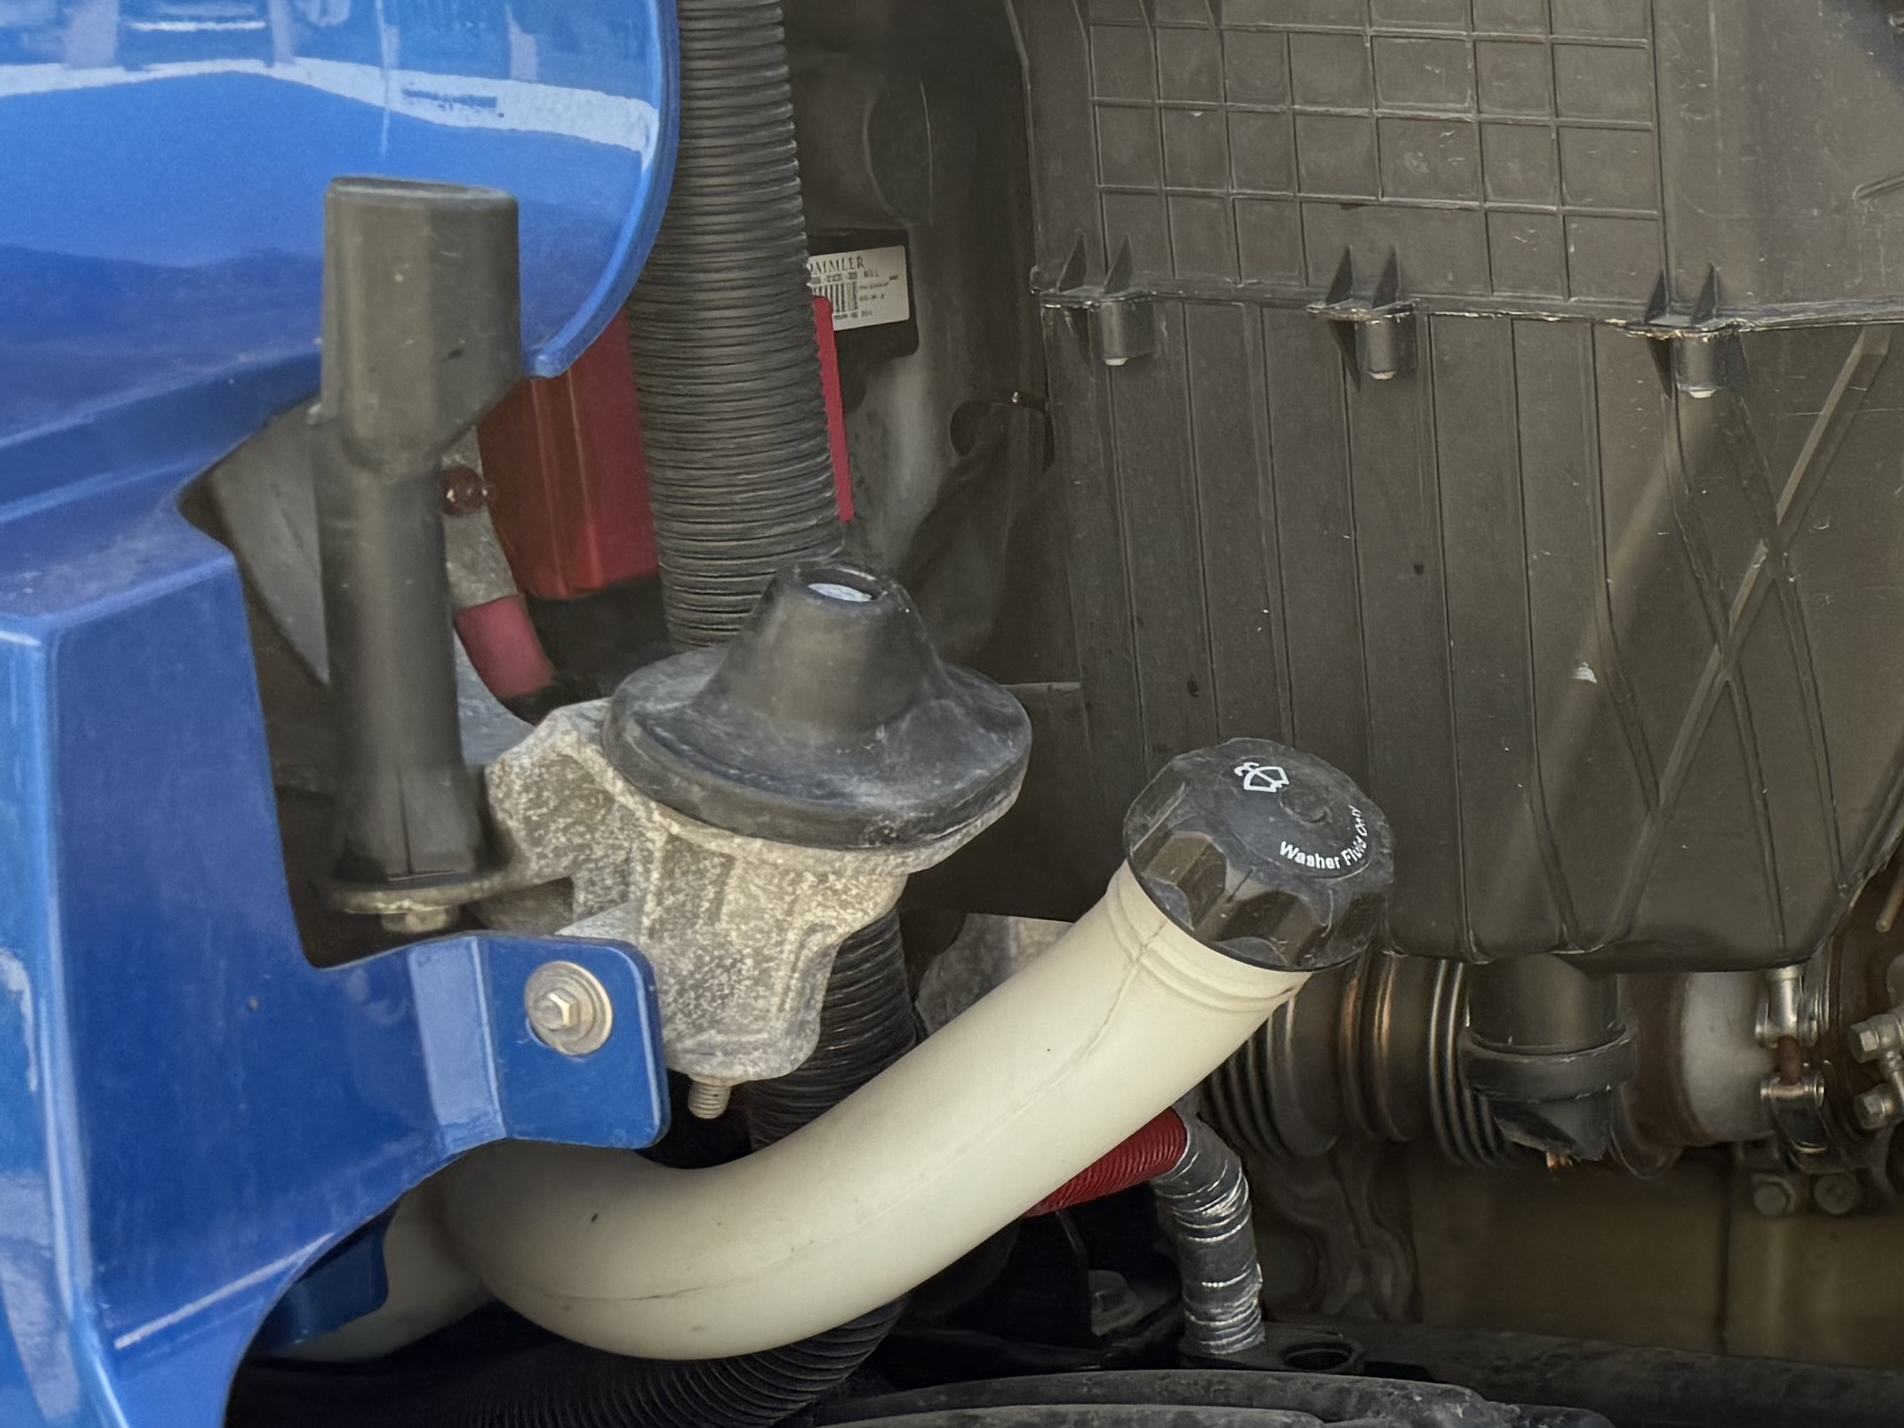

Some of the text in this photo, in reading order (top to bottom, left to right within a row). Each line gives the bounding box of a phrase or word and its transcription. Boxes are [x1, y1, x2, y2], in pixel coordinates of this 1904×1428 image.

[1280, 804, 1368, 869] Washer Fluid Only
